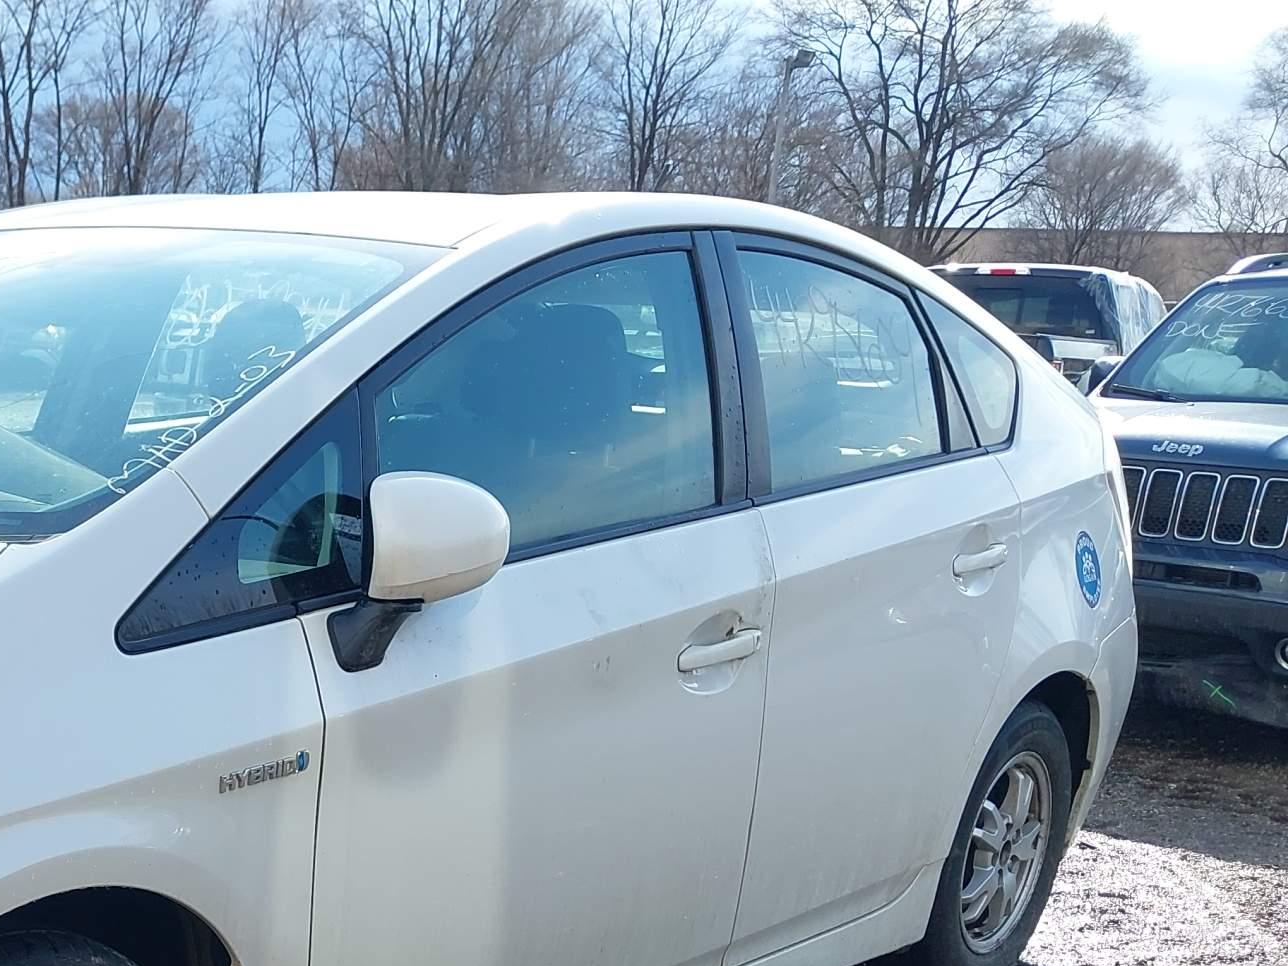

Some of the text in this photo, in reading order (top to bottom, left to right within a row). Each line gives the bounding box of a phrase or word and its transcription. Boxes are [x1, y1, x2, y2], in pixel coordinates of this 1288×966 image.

[1165, 318, 1265, 341] DONE
[1152, 440, 1203, 457] Jeep
[219, 757, 296, 793] HYBRID
